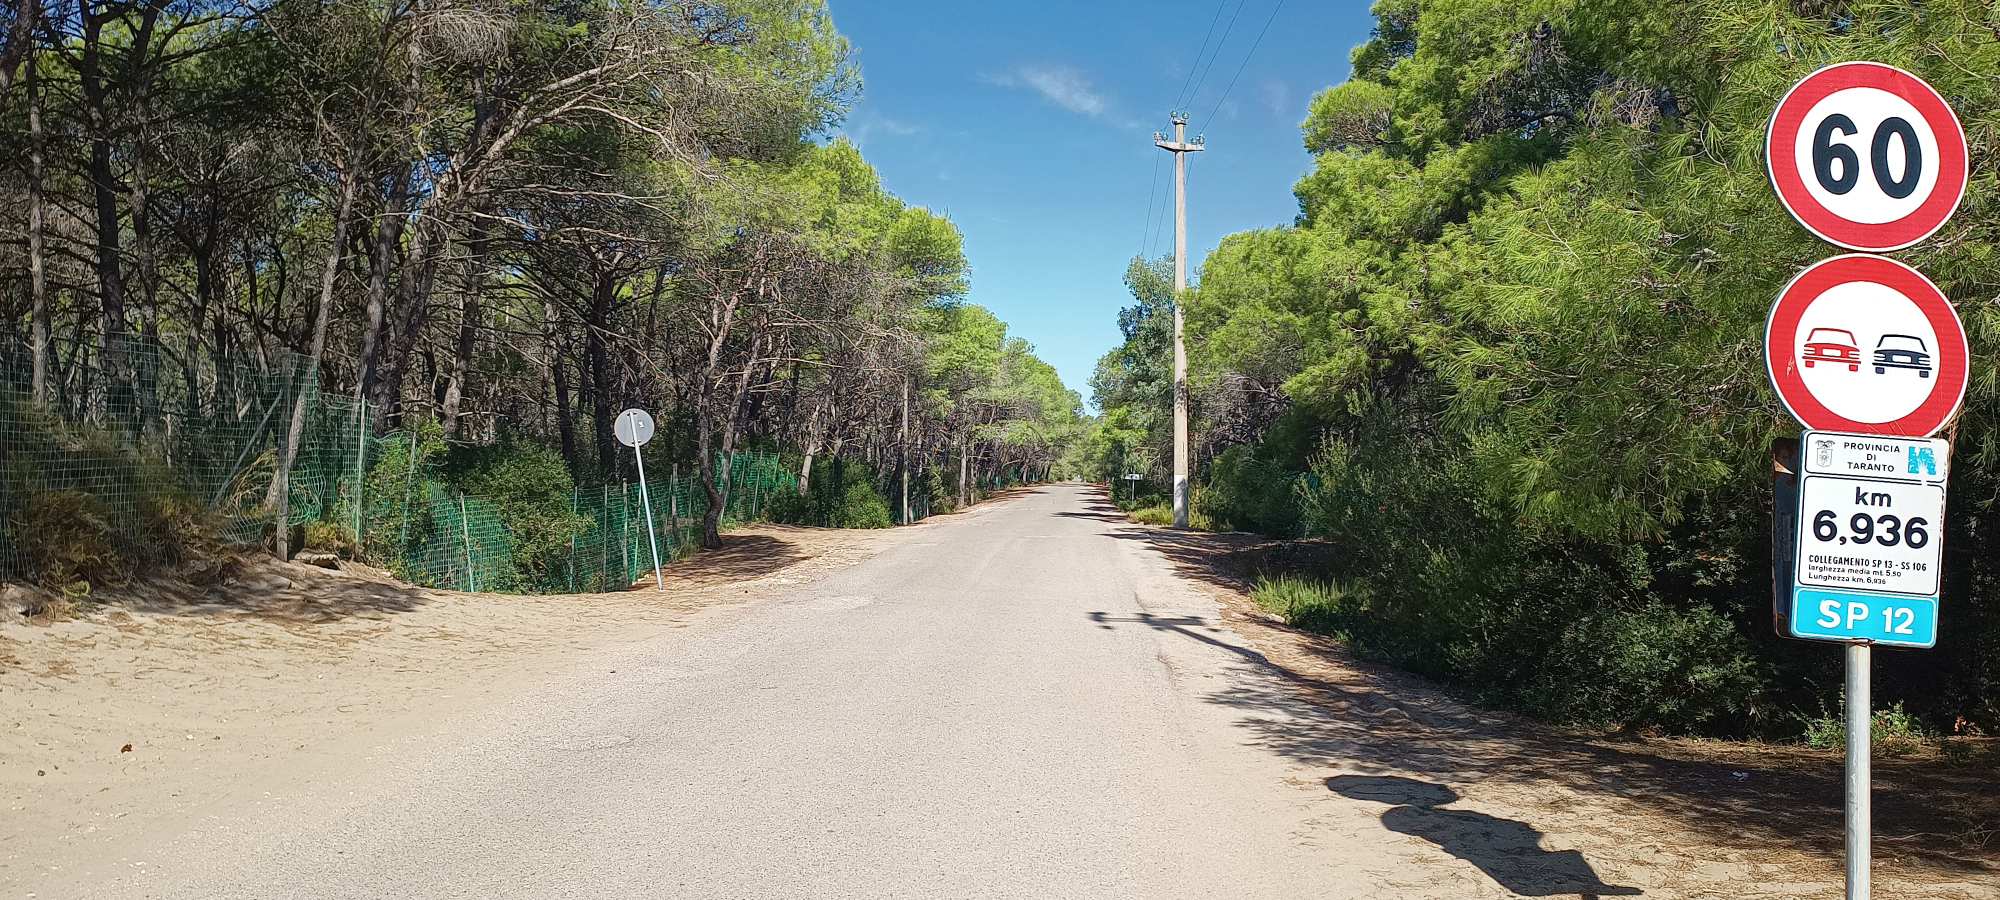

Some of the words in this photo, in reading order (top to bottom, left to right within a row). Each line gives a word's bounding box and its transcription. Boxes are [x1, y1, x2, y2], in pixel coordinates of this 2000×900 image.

[1812, 113, 1922, 199] 60
[1844, 442, 1900, 453] PROVINCIA
[1847, 462, 1895, 472] TARANTO
[1855, 486, 1892, 507] km
[1813, 510, 1929, 549] 6,936
[1808, 555, 1870, 567] COLLEGAMENTO
[1872, 560, 1883, 568] SP
[1885, 560, 1893, 569] 13
[1901, 562, 1910, 570] SS
[1913, 562, 1927, 571] 106
[1808, 572, 1850, 582] Lunghezza
[1816, 599, 1869, 630] SP
[1881, 607, 1915, 634] 12
